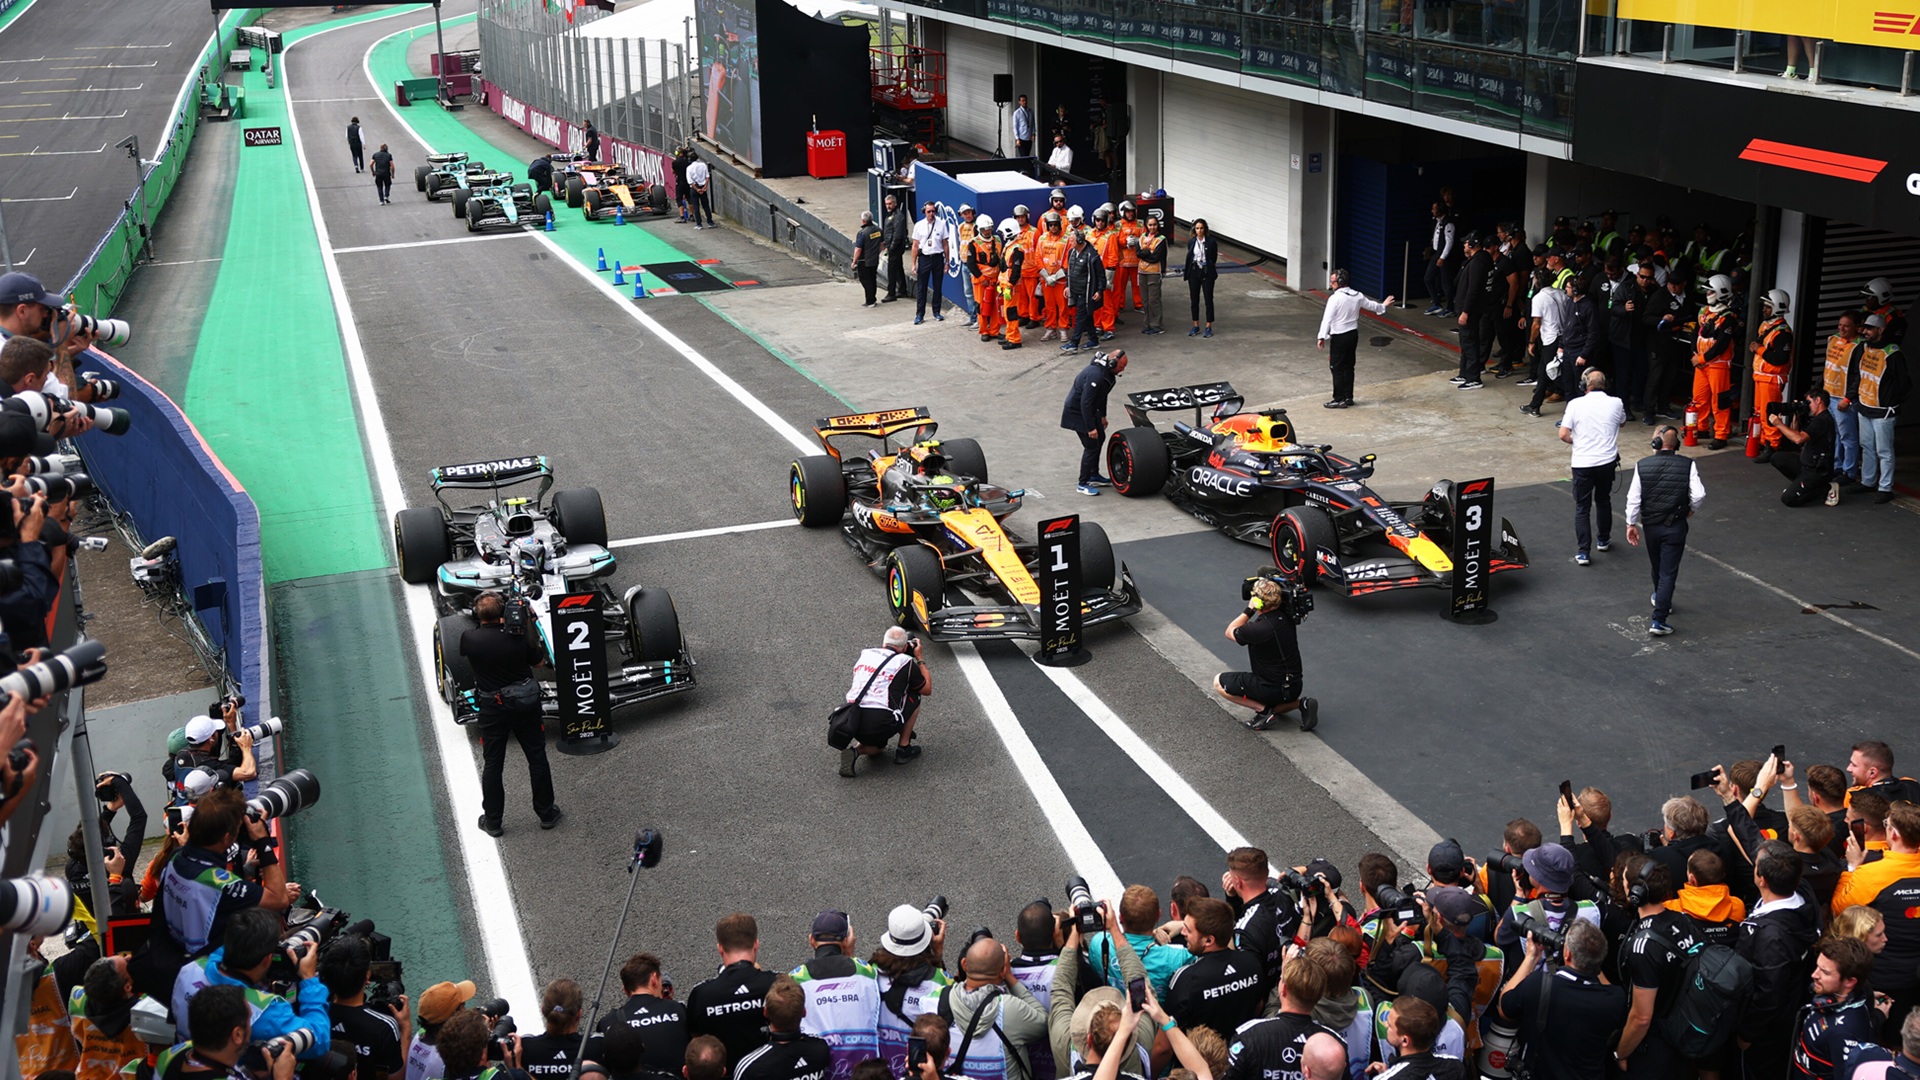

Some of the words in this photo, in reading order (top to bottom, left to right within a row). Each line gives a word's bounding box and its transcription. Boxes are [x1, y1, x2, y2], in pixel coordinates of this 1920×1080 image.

[245, 130, 280, 141] QATAR
[816, 136, 843, 148] MOËT
[1189, 430, 1214, 445] HONDA
[446, 458, 532, 476] PETRONAS
[1192, 467, 1253, 498] ORACLE
[1305, 490, 1330, 504] CARLYLE
[1465, 504, 1482, 531] 3
[975, 524, 996, 535] 4
[1050, 544, 1069, 572] 1
[1316, 550, 1337, 565] Mobil
[1465, 538, 1480, 589] MOËT
[1343, 563, 1389, 580] VISA
[1053, 579, 1069, 631] MOËT
[566, 621, 590, 651] 2
[572, 658, 596, 715] MOËT
[580, 717, 606, 733] Paulo
[579, 731, 595, 739] 2025
[1893, 888, 1920, 896] McLa
[1203, 974, 1259, 1000] PETRONAS
[706, 998, 766, 1016] PETRON
[816, 994, 860, 1006] 0945-BRA
[627, 1013, 680, 1028] RONAS
[528, 1064, 573, 1074] PETRON
[962, 1061, 1001, 1070] COURSE
[1263, 1068, 1304, 1080] PETRO
